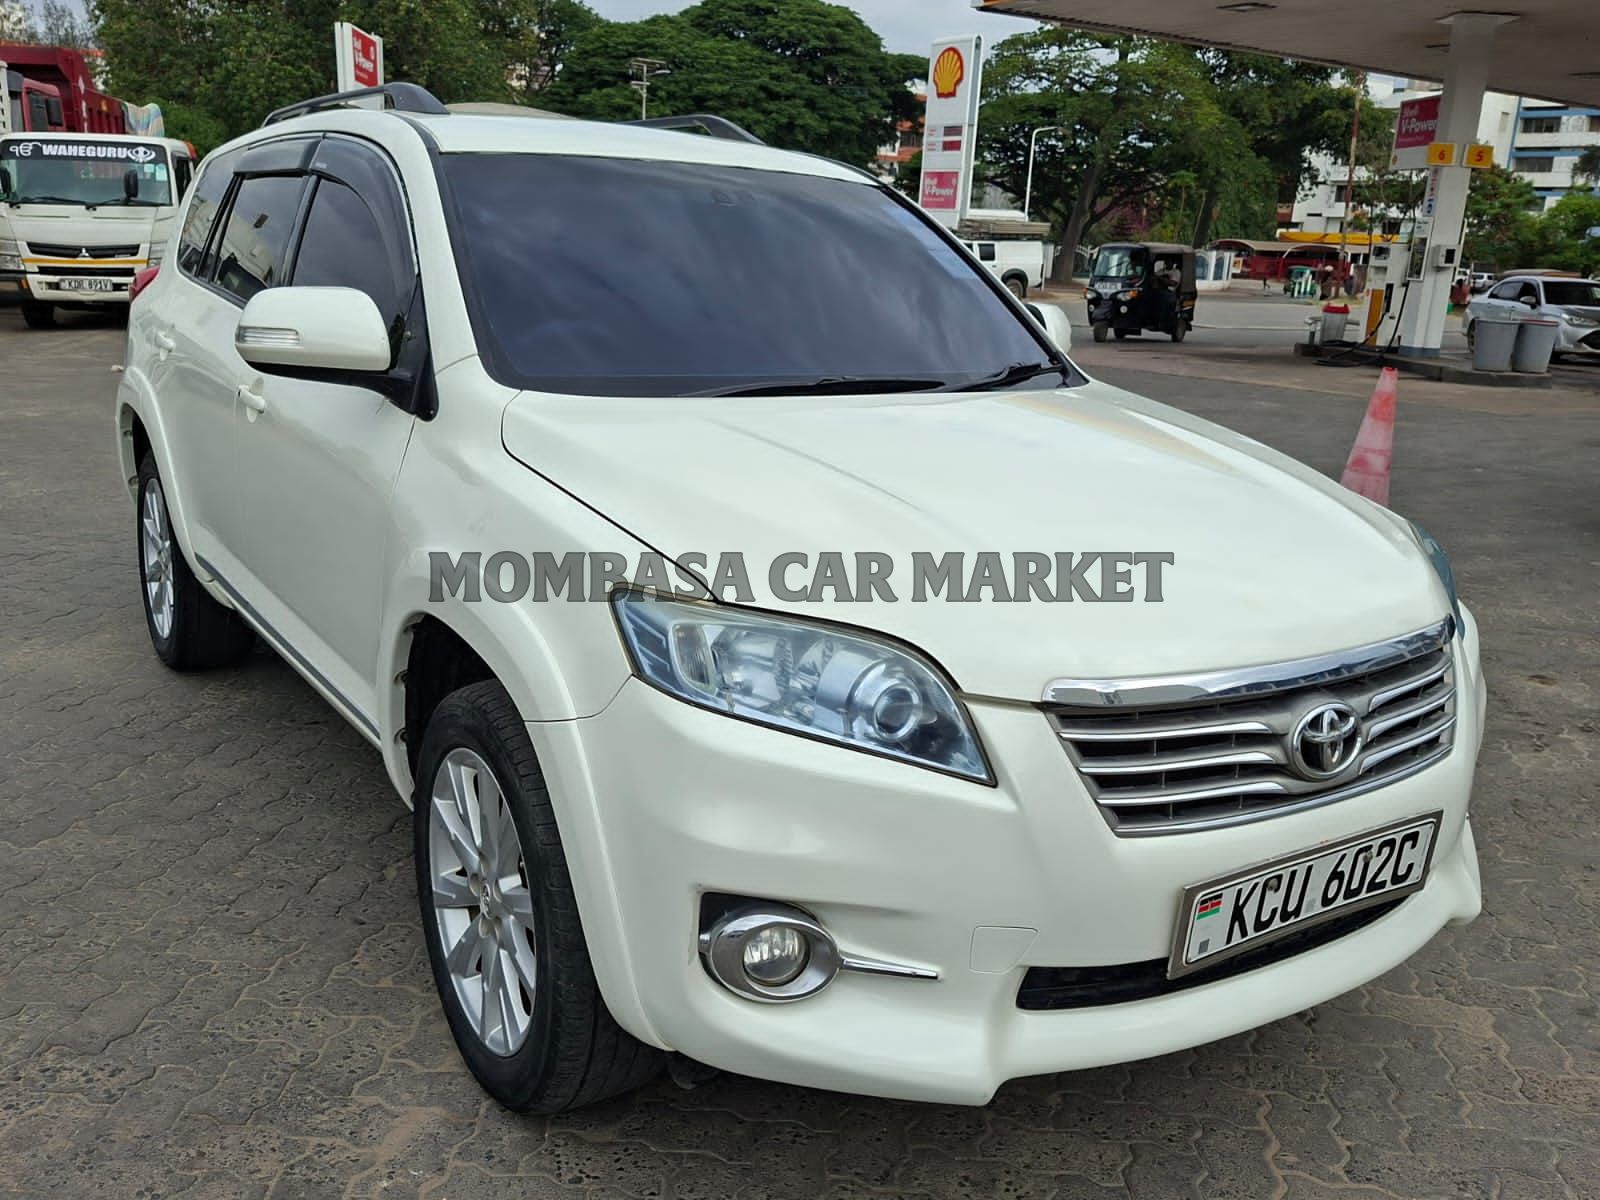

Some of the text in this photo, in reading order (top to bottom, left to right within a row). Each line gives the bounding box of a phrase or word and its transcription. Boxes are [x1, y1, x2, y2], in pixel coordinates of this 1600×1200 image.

[41, 144, 128, 158] WAHEGURU
[1438, 149, 1446, 161] 6
[1474, 151, 1484, 162] 5
[1225, 830, 1420, 946] KCU 602C
